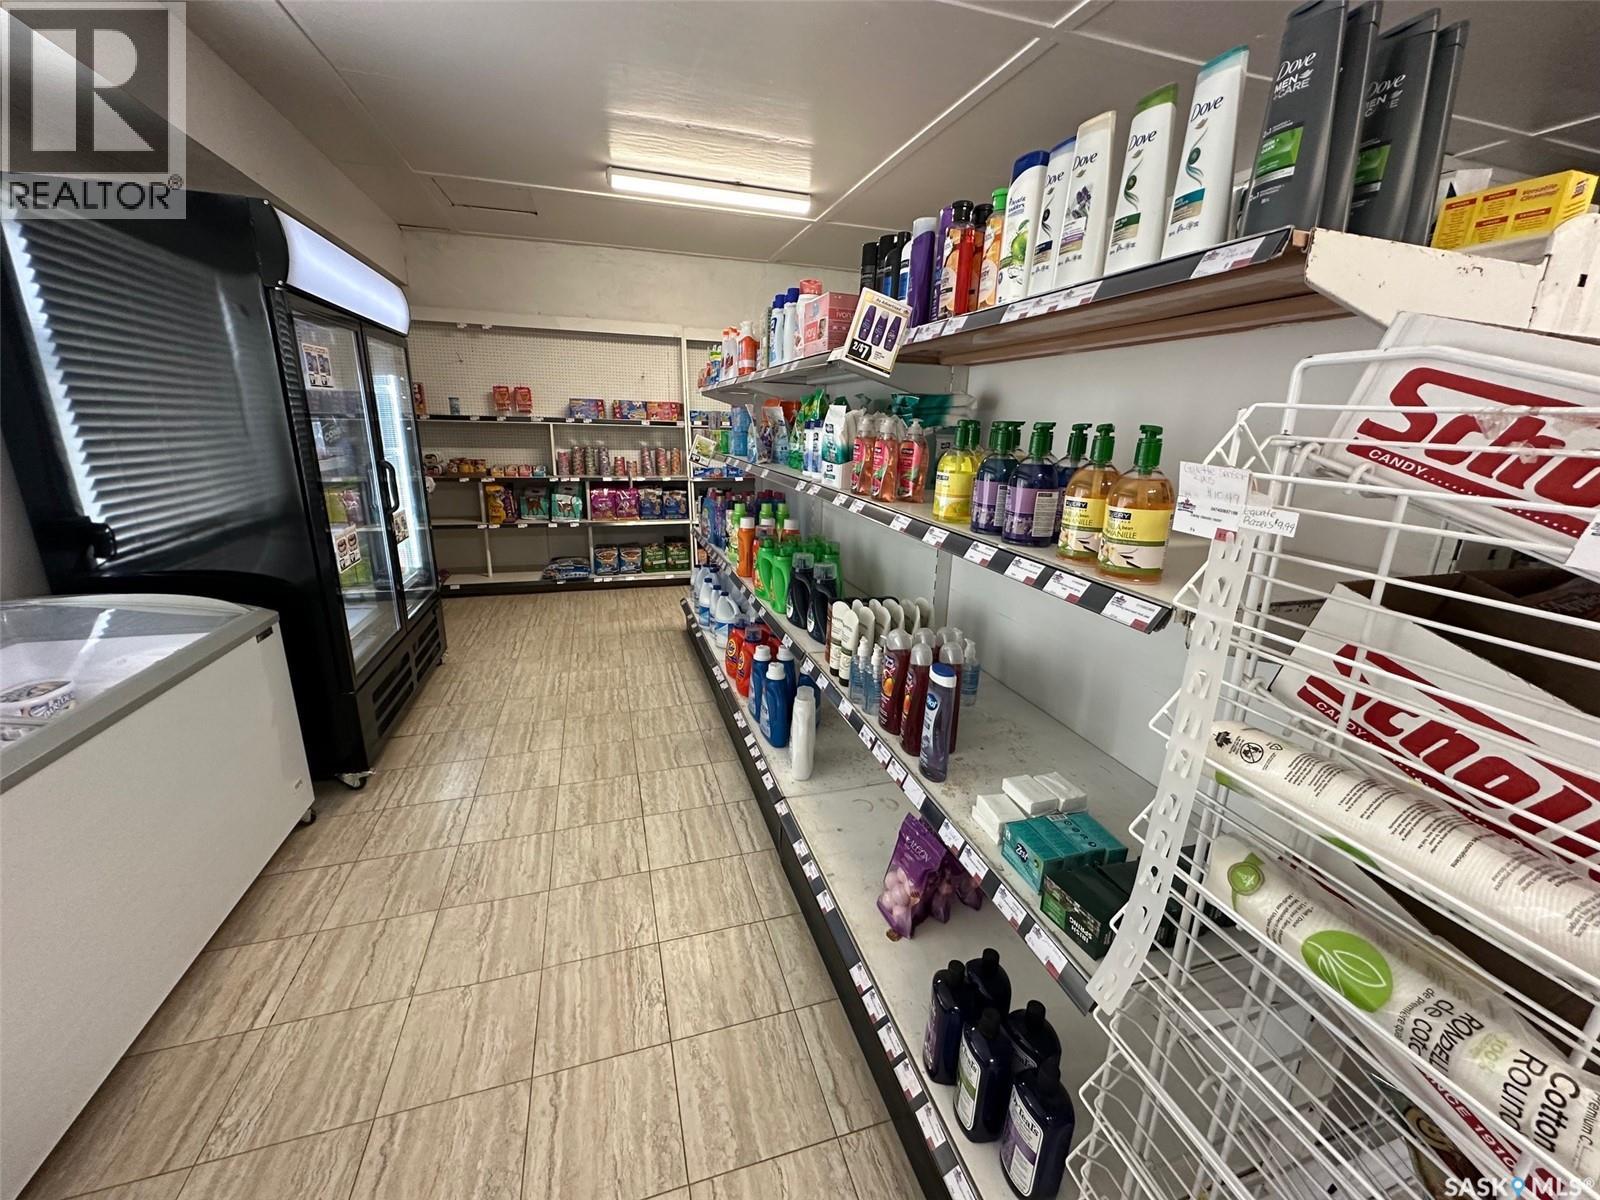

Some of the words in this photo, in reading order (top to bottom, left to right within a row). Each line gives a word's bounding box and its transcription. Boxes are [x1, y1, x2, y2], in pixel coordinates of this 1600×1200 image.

[1276, 52, 1317, 82] Dove
[1274, 73, 1299, 94] MEN
[1190, 95, 1224, 123] Dove
[1127, 130, 1157, 151] Dove
[1072, 152, 1098, 172] Dove
[1069, 915, 1093, 940] SPRING
[1423, 999, 1455, 1018] de
[1428, 1012, 1485, 1073] RONDELL
[1498, 1048, 1549, 1139] Round
[1533, 1071, 1581, 1153] Cotton
[1474, 1124, 1516, 1168] 1910
